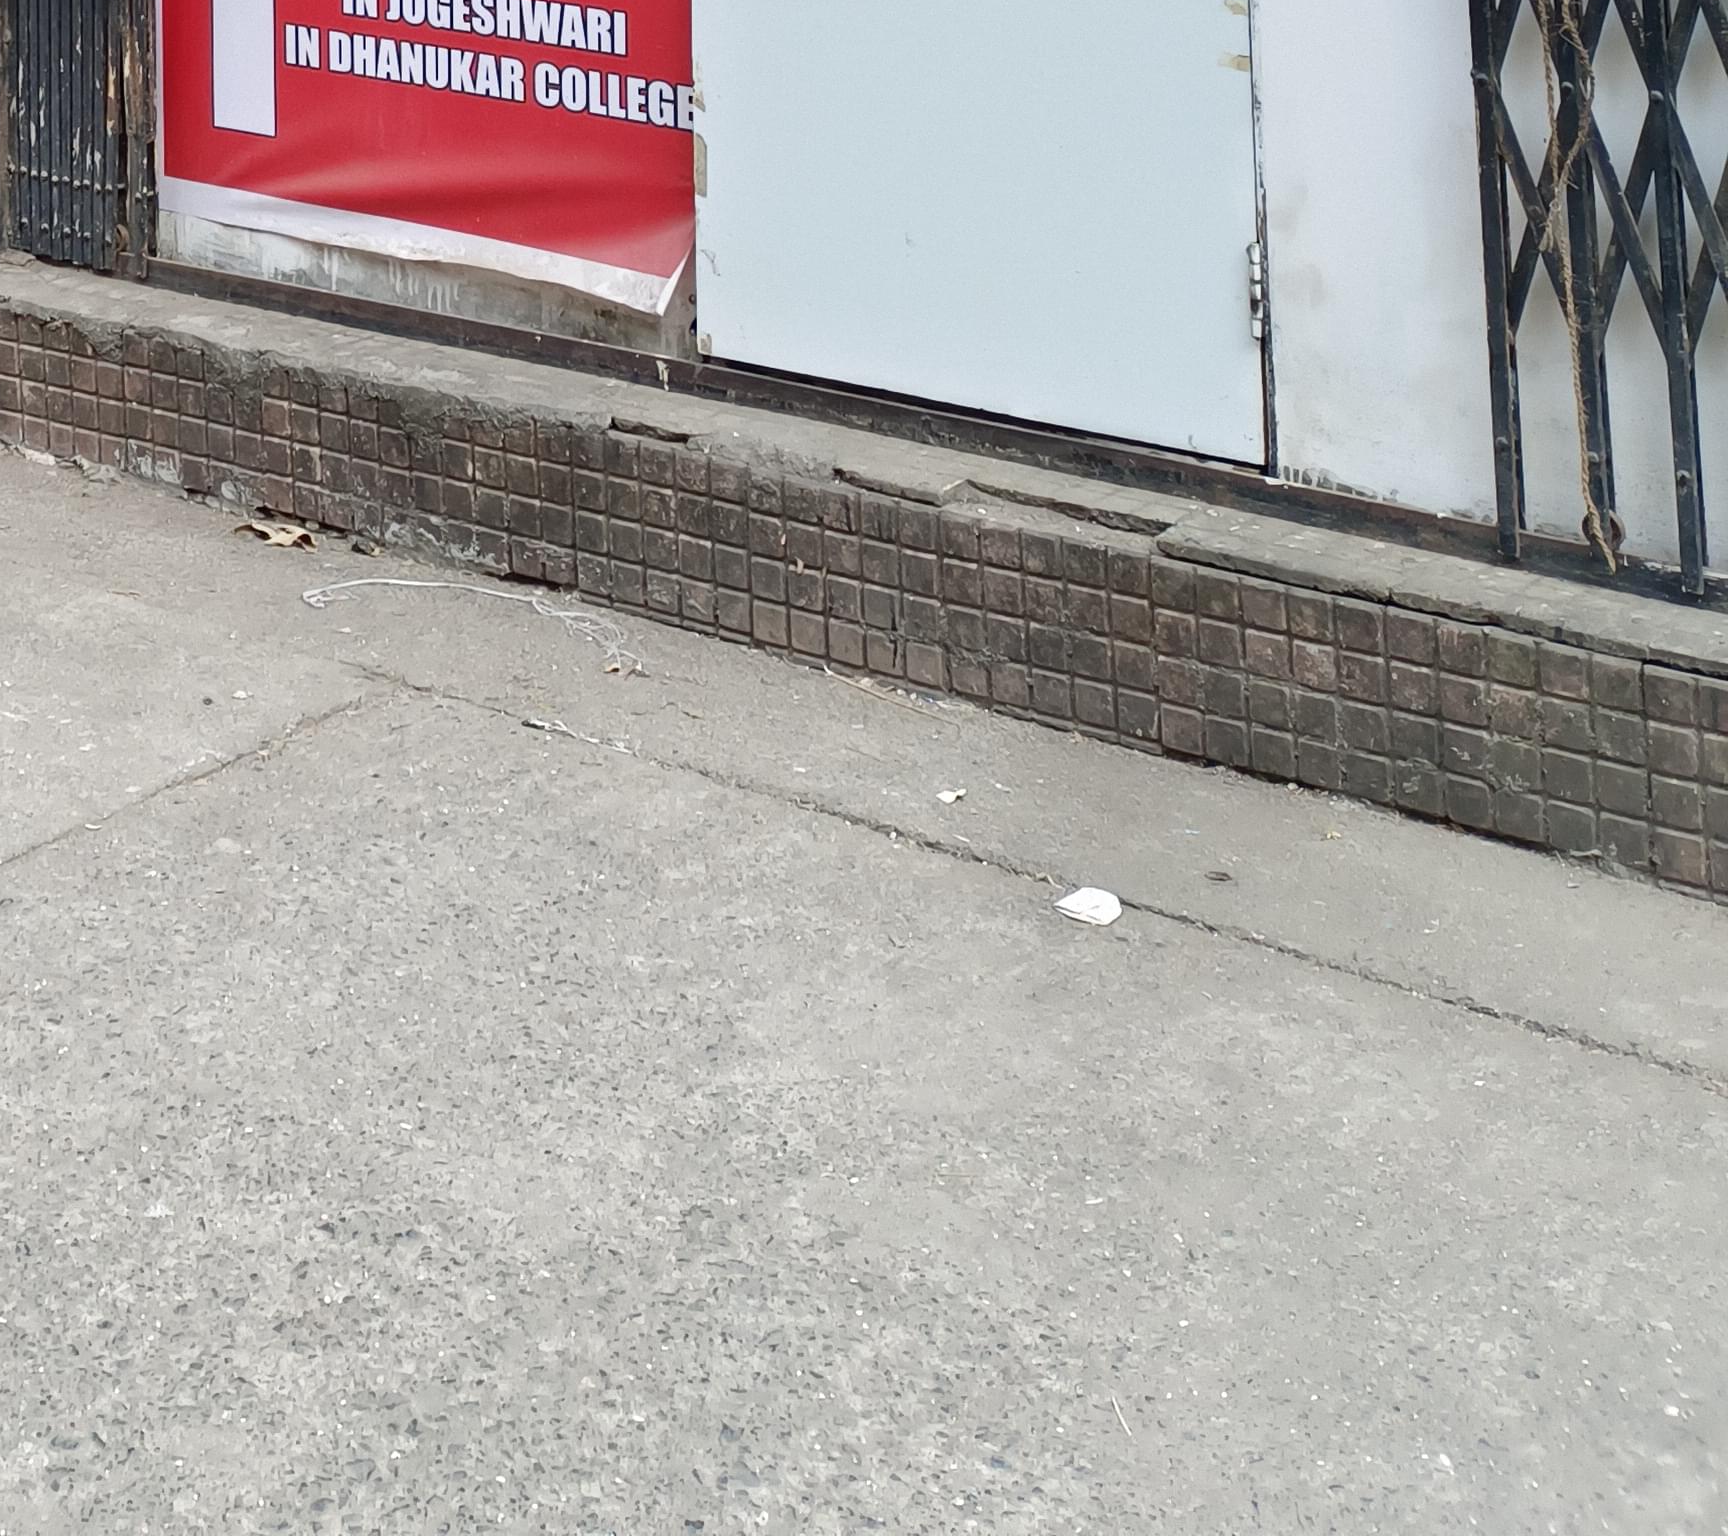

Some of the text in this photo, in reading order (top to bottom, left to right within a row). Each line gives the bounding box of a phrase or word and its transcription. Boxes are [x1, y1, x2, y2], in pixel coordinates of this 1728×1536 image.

[285, 22, 694, 133] IN DHANUKAR COLLEGE
